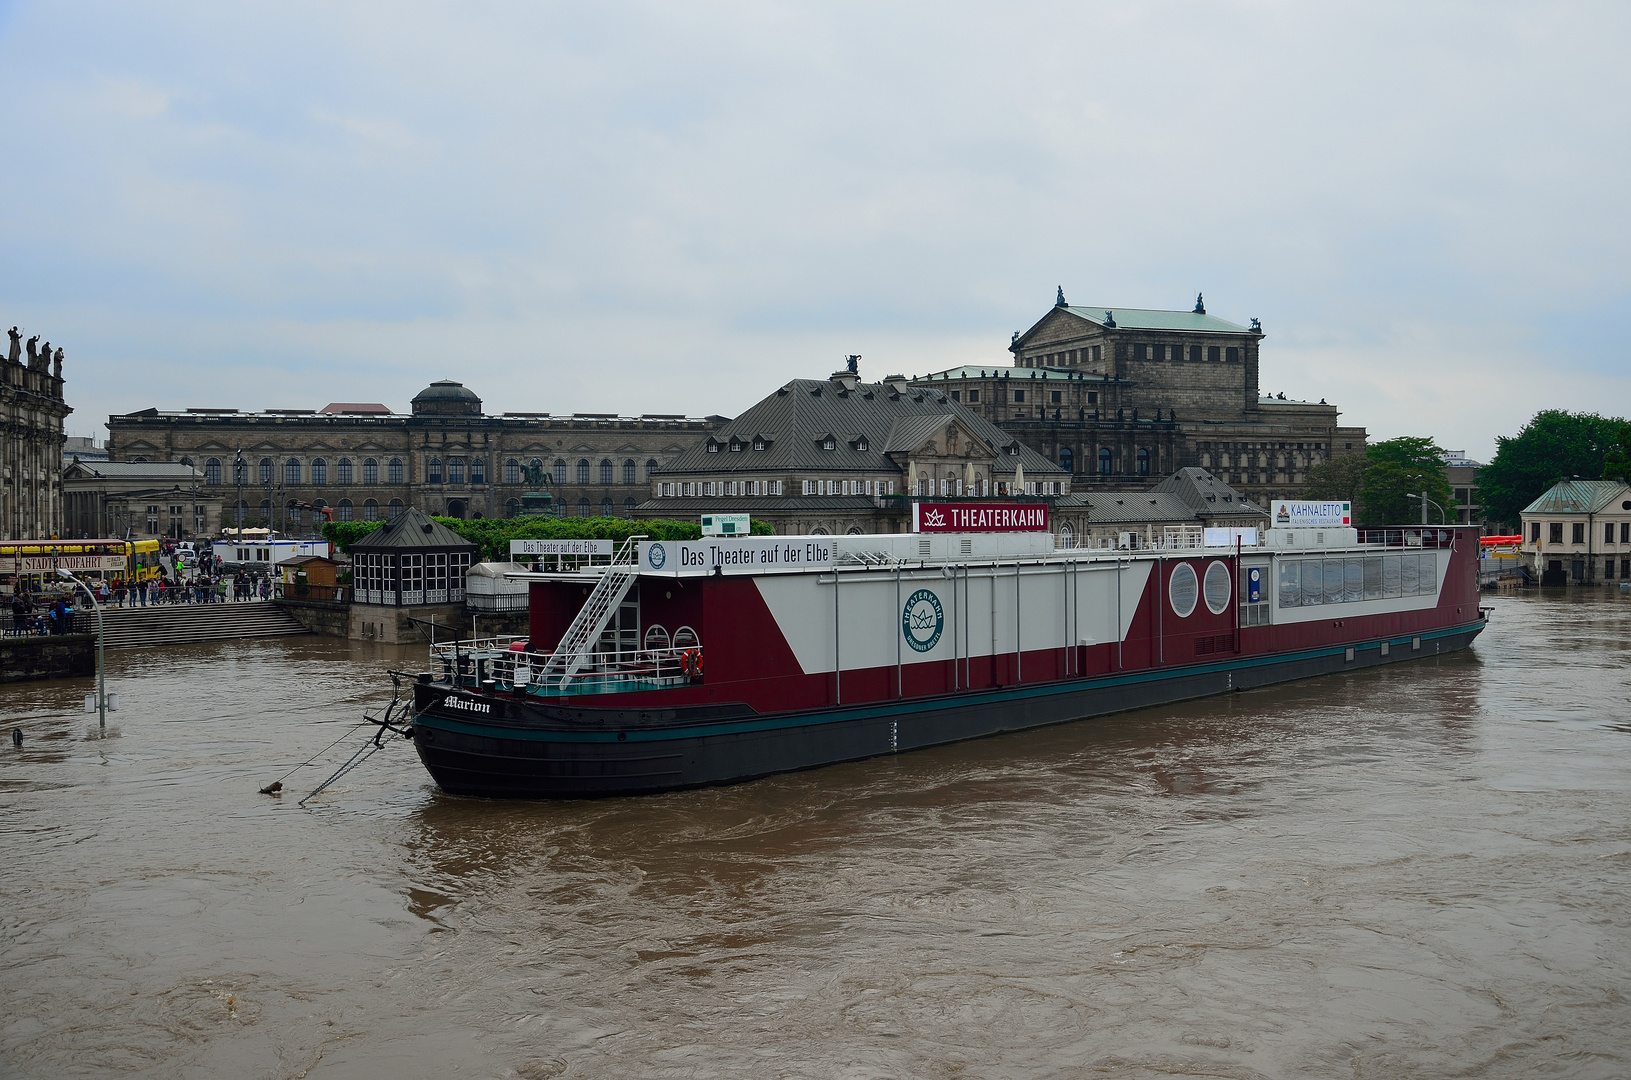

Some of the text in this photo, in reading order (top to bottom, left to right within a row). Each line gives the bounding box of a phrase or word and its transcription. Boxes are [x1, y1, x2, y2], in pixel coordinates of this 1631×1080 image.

[951, 509, 1044, 527] THEATERKAHN
[1291, 504, 1341, 517] KAHNALETTO
[715, 515, 728, 523] Pegel
[523, 541, 598, 553] Das Theater auf der Elbe
[681, 546, 705, 566] Das
[709, 545, 756, 565] Theater
[760, 544, 779, 563] auf
[783, 544, 801, 563] der
[806, 543, 829, 562] Elbe
[25, 556, 102, 570] STADTRUNDFAHRT
[904, 591, 943, 625] THEATERKAHN
[443, 695, 491, 714] Marion
